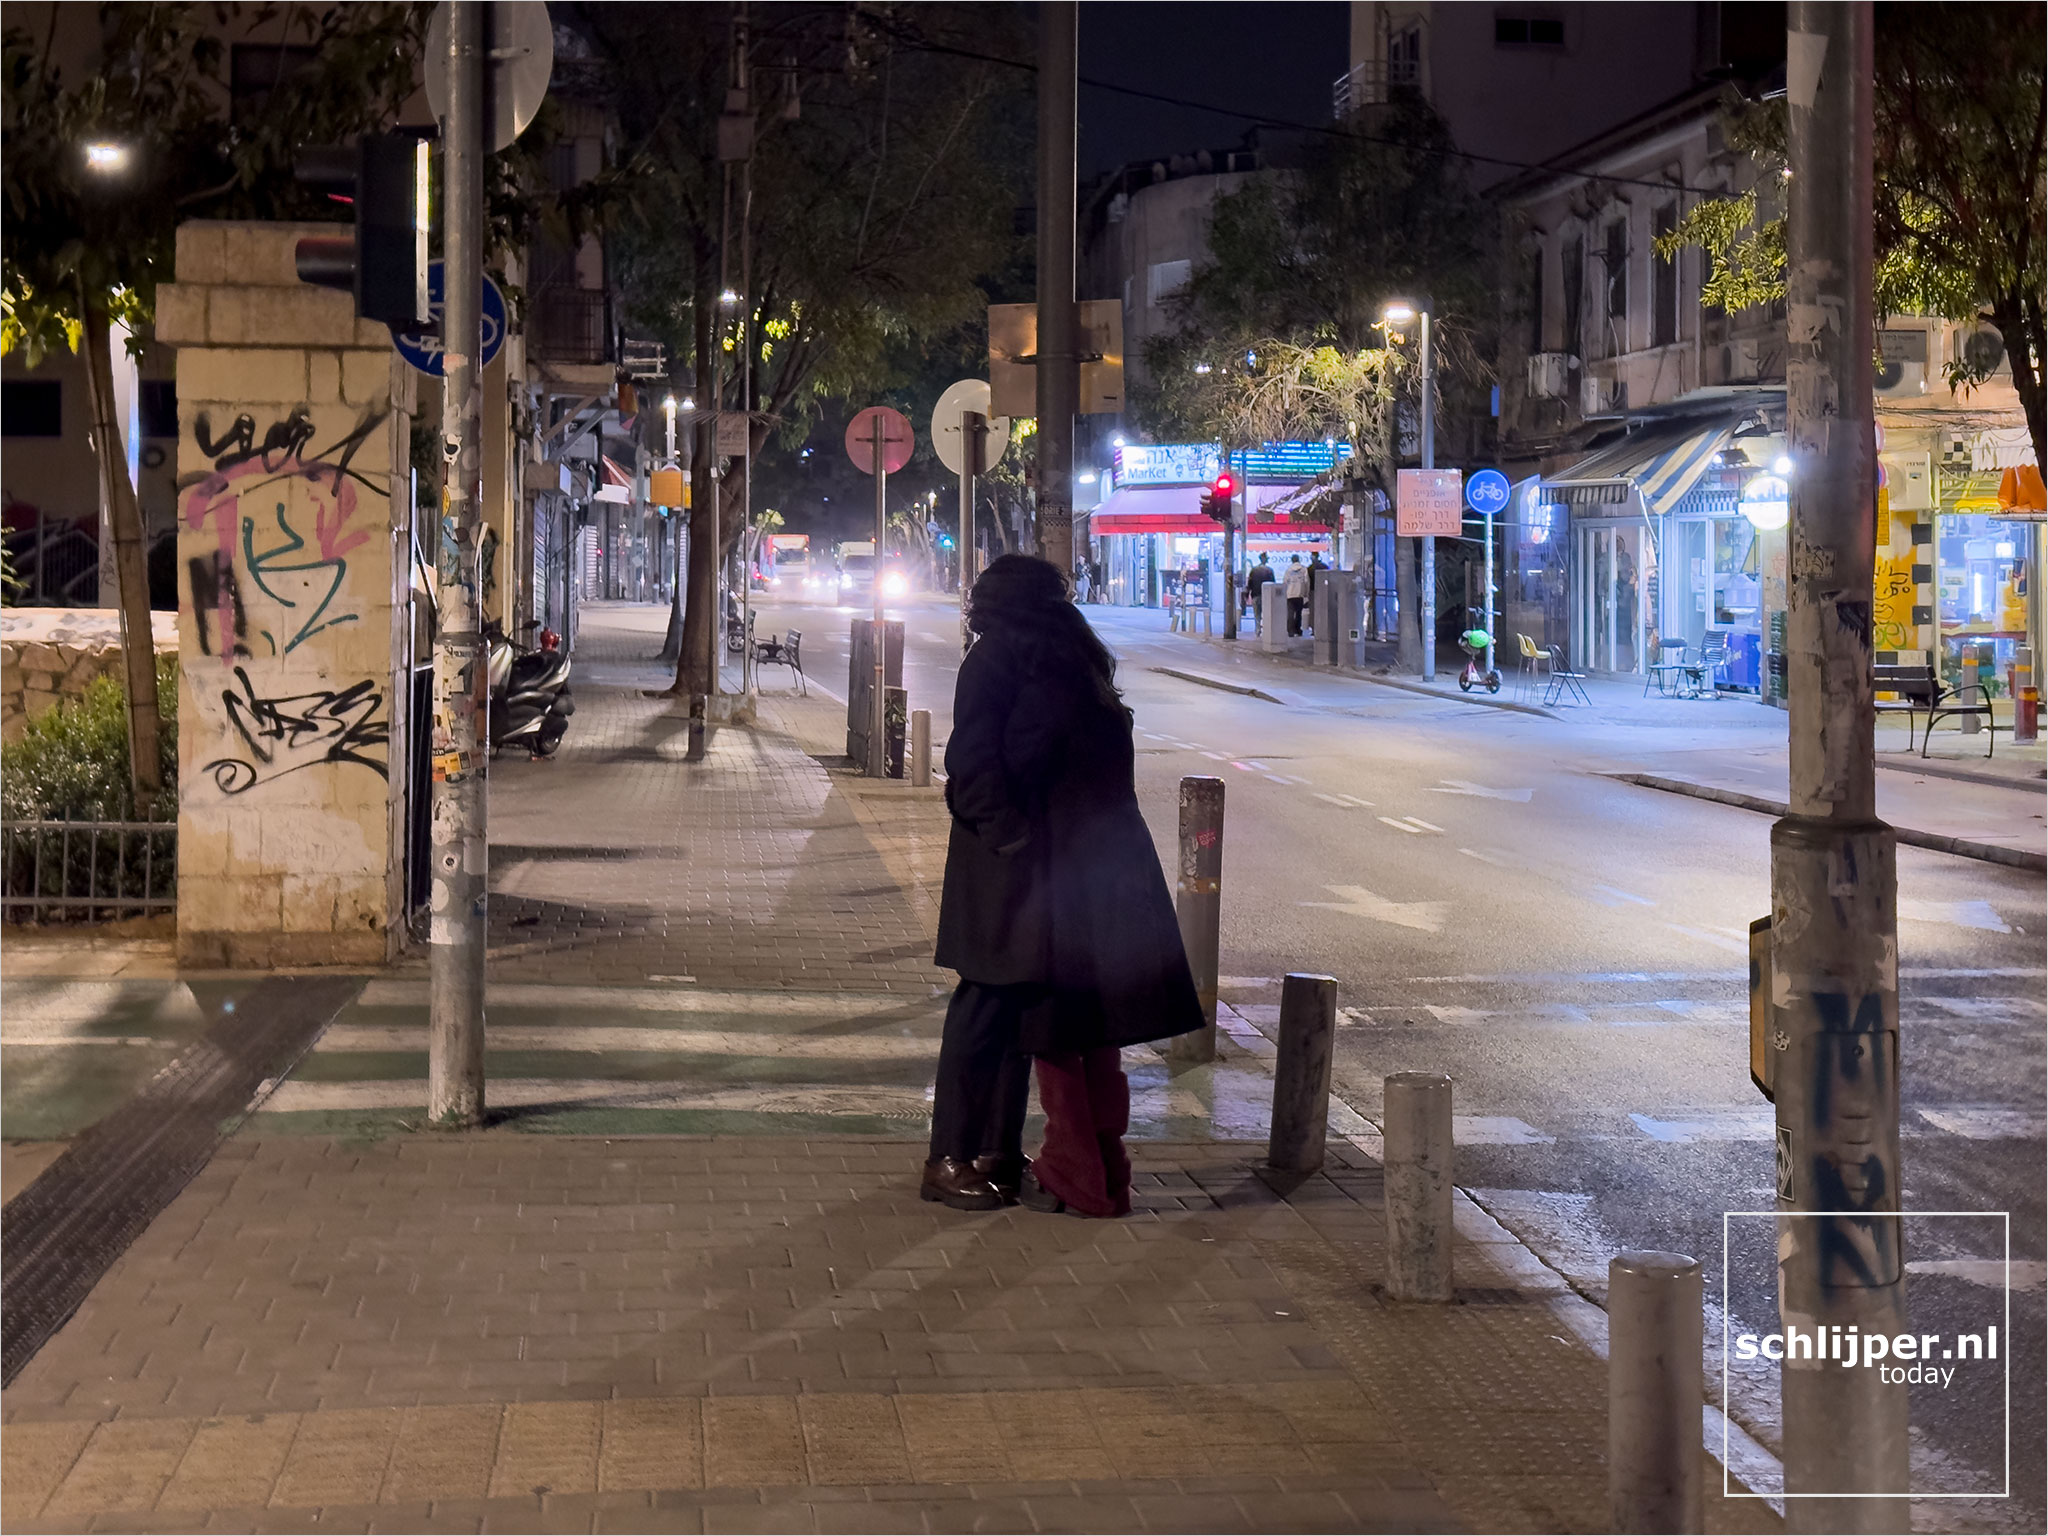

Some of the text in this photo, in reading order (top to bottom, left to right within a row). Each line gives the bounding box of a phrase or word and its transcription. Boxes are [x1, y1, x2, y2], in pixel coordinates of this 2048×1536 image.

[1433, 500, 1457, 508] חסום
[1432, 510, 1449, 520] דרך
[1404, 520, 1433, 530] שלמה
